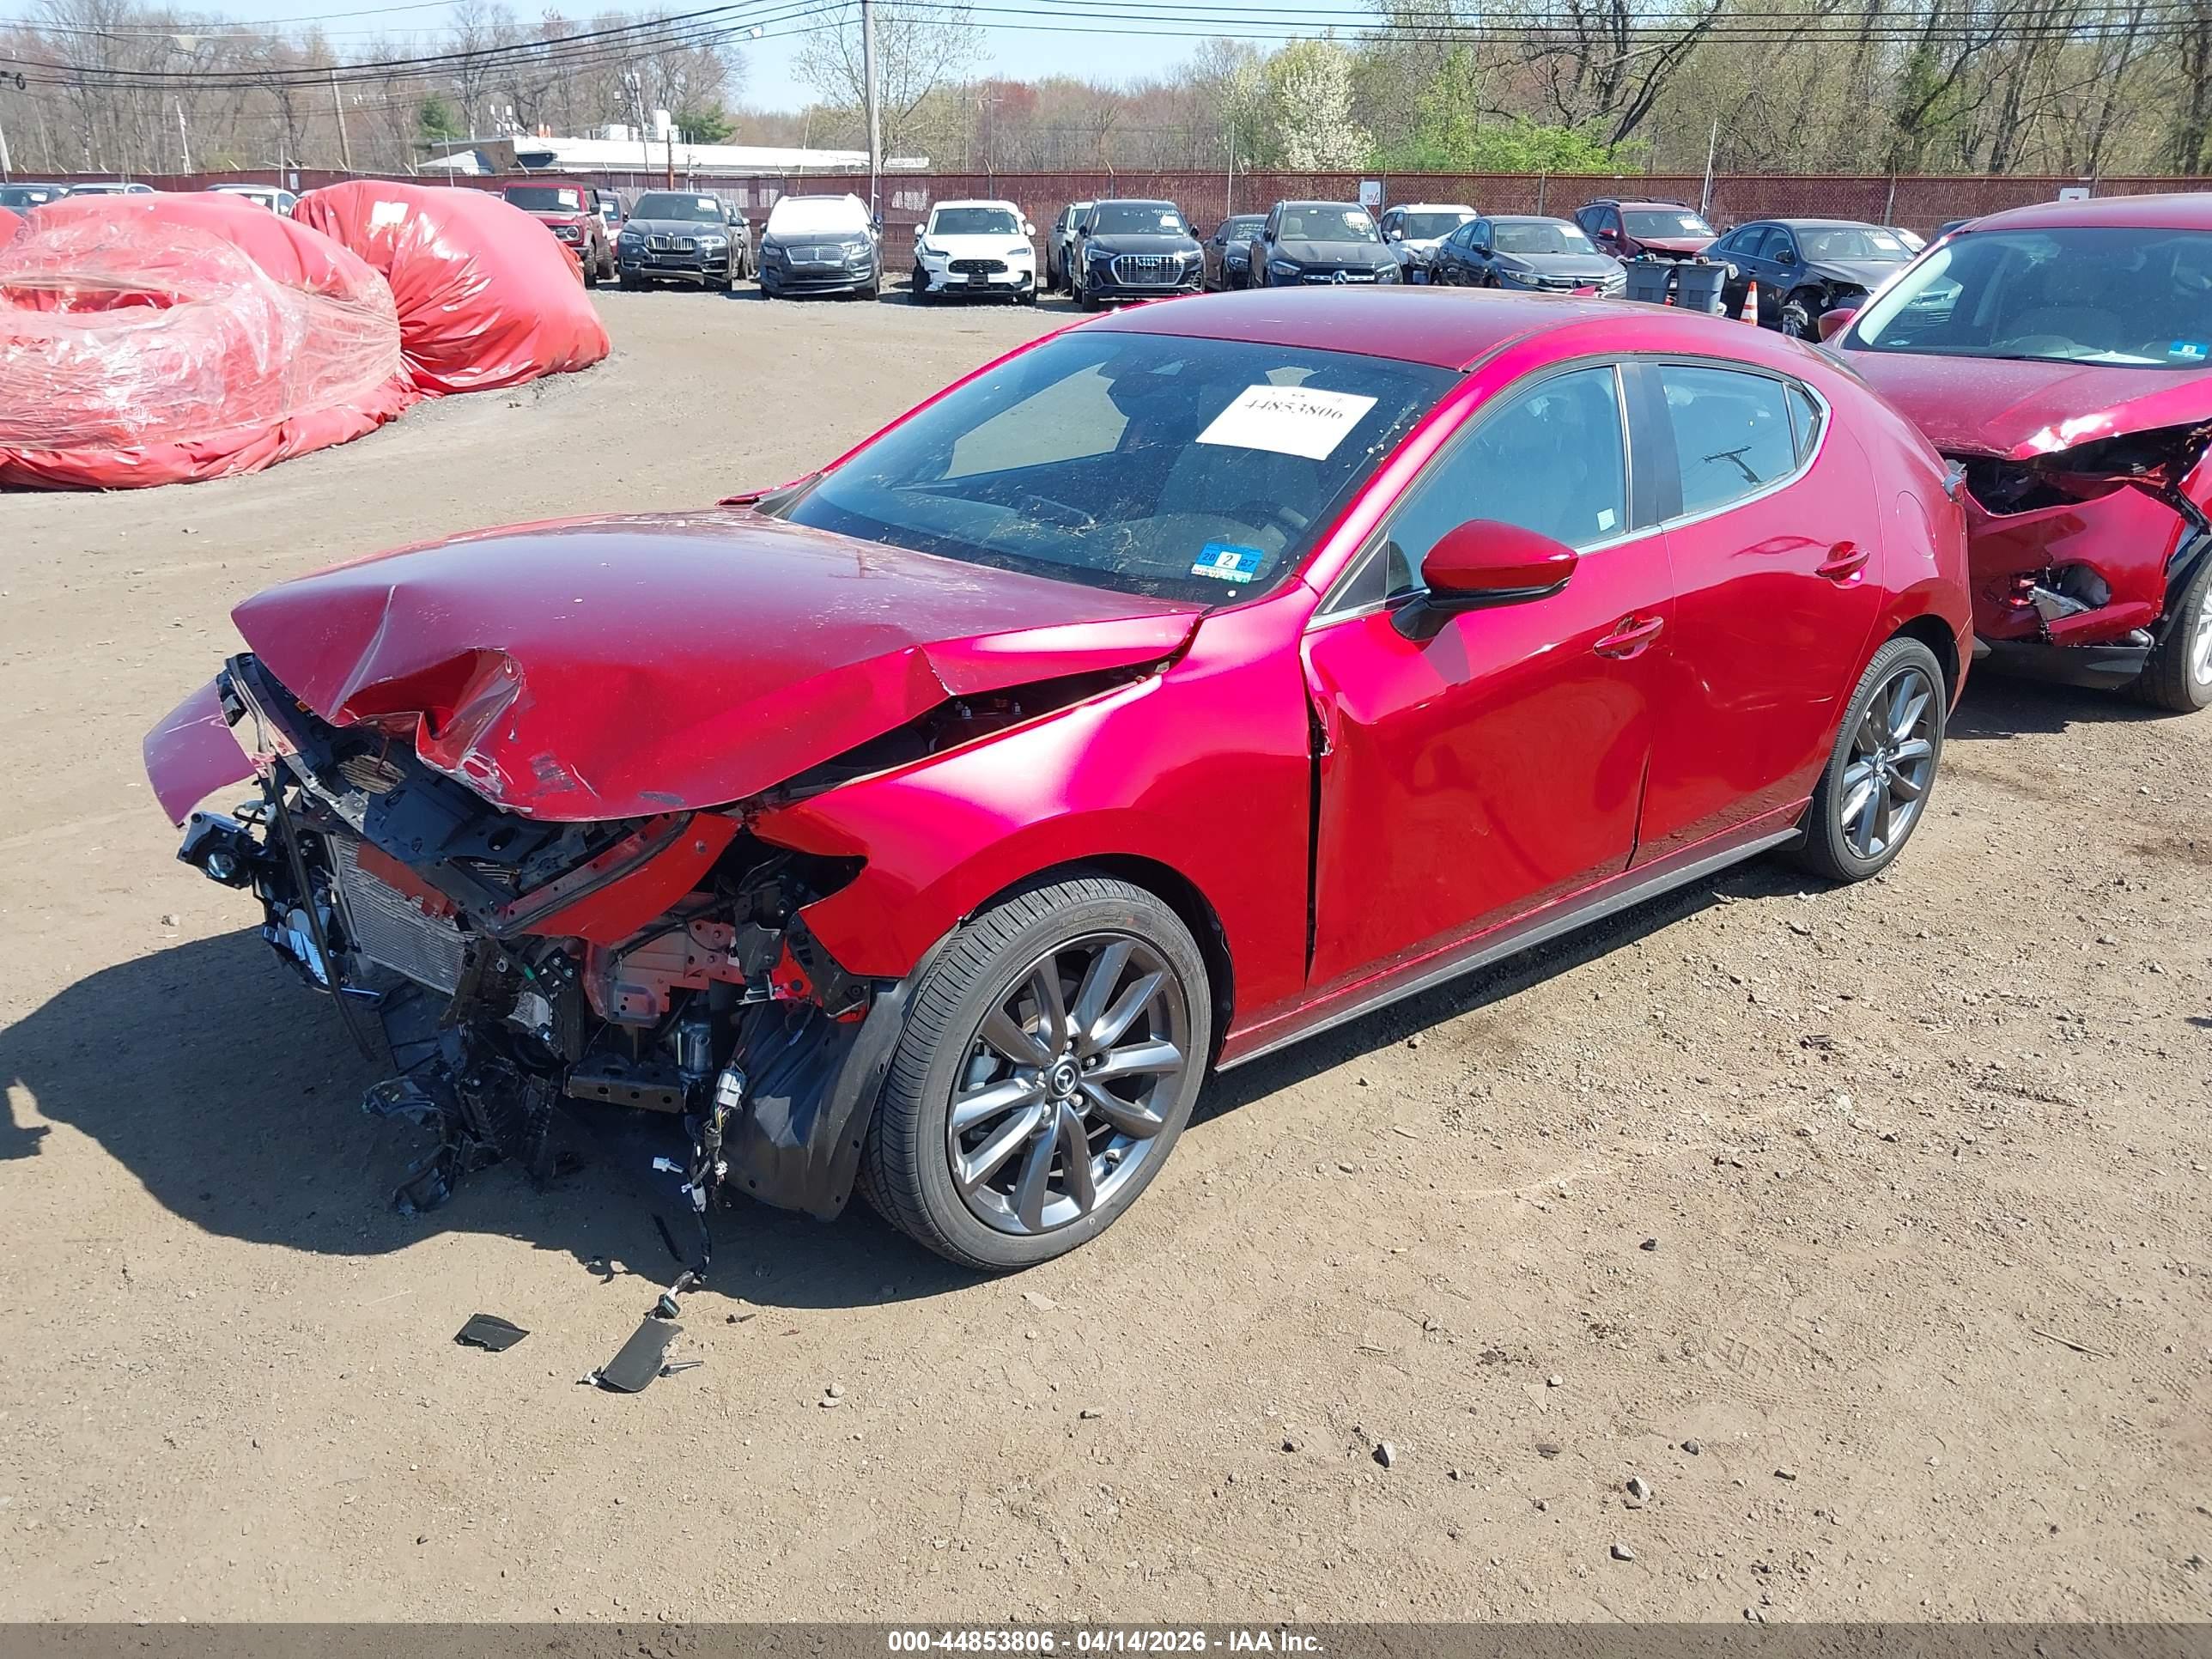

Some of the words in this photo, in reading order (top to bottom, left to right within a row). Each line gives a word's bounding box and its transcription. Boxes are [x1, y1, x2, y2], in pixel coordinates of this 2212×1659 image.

[1245, 399, 1344, 419] 44853806
[1202, 552, 1217, 561] 20
[1222, 555, 1234, 566] 2
